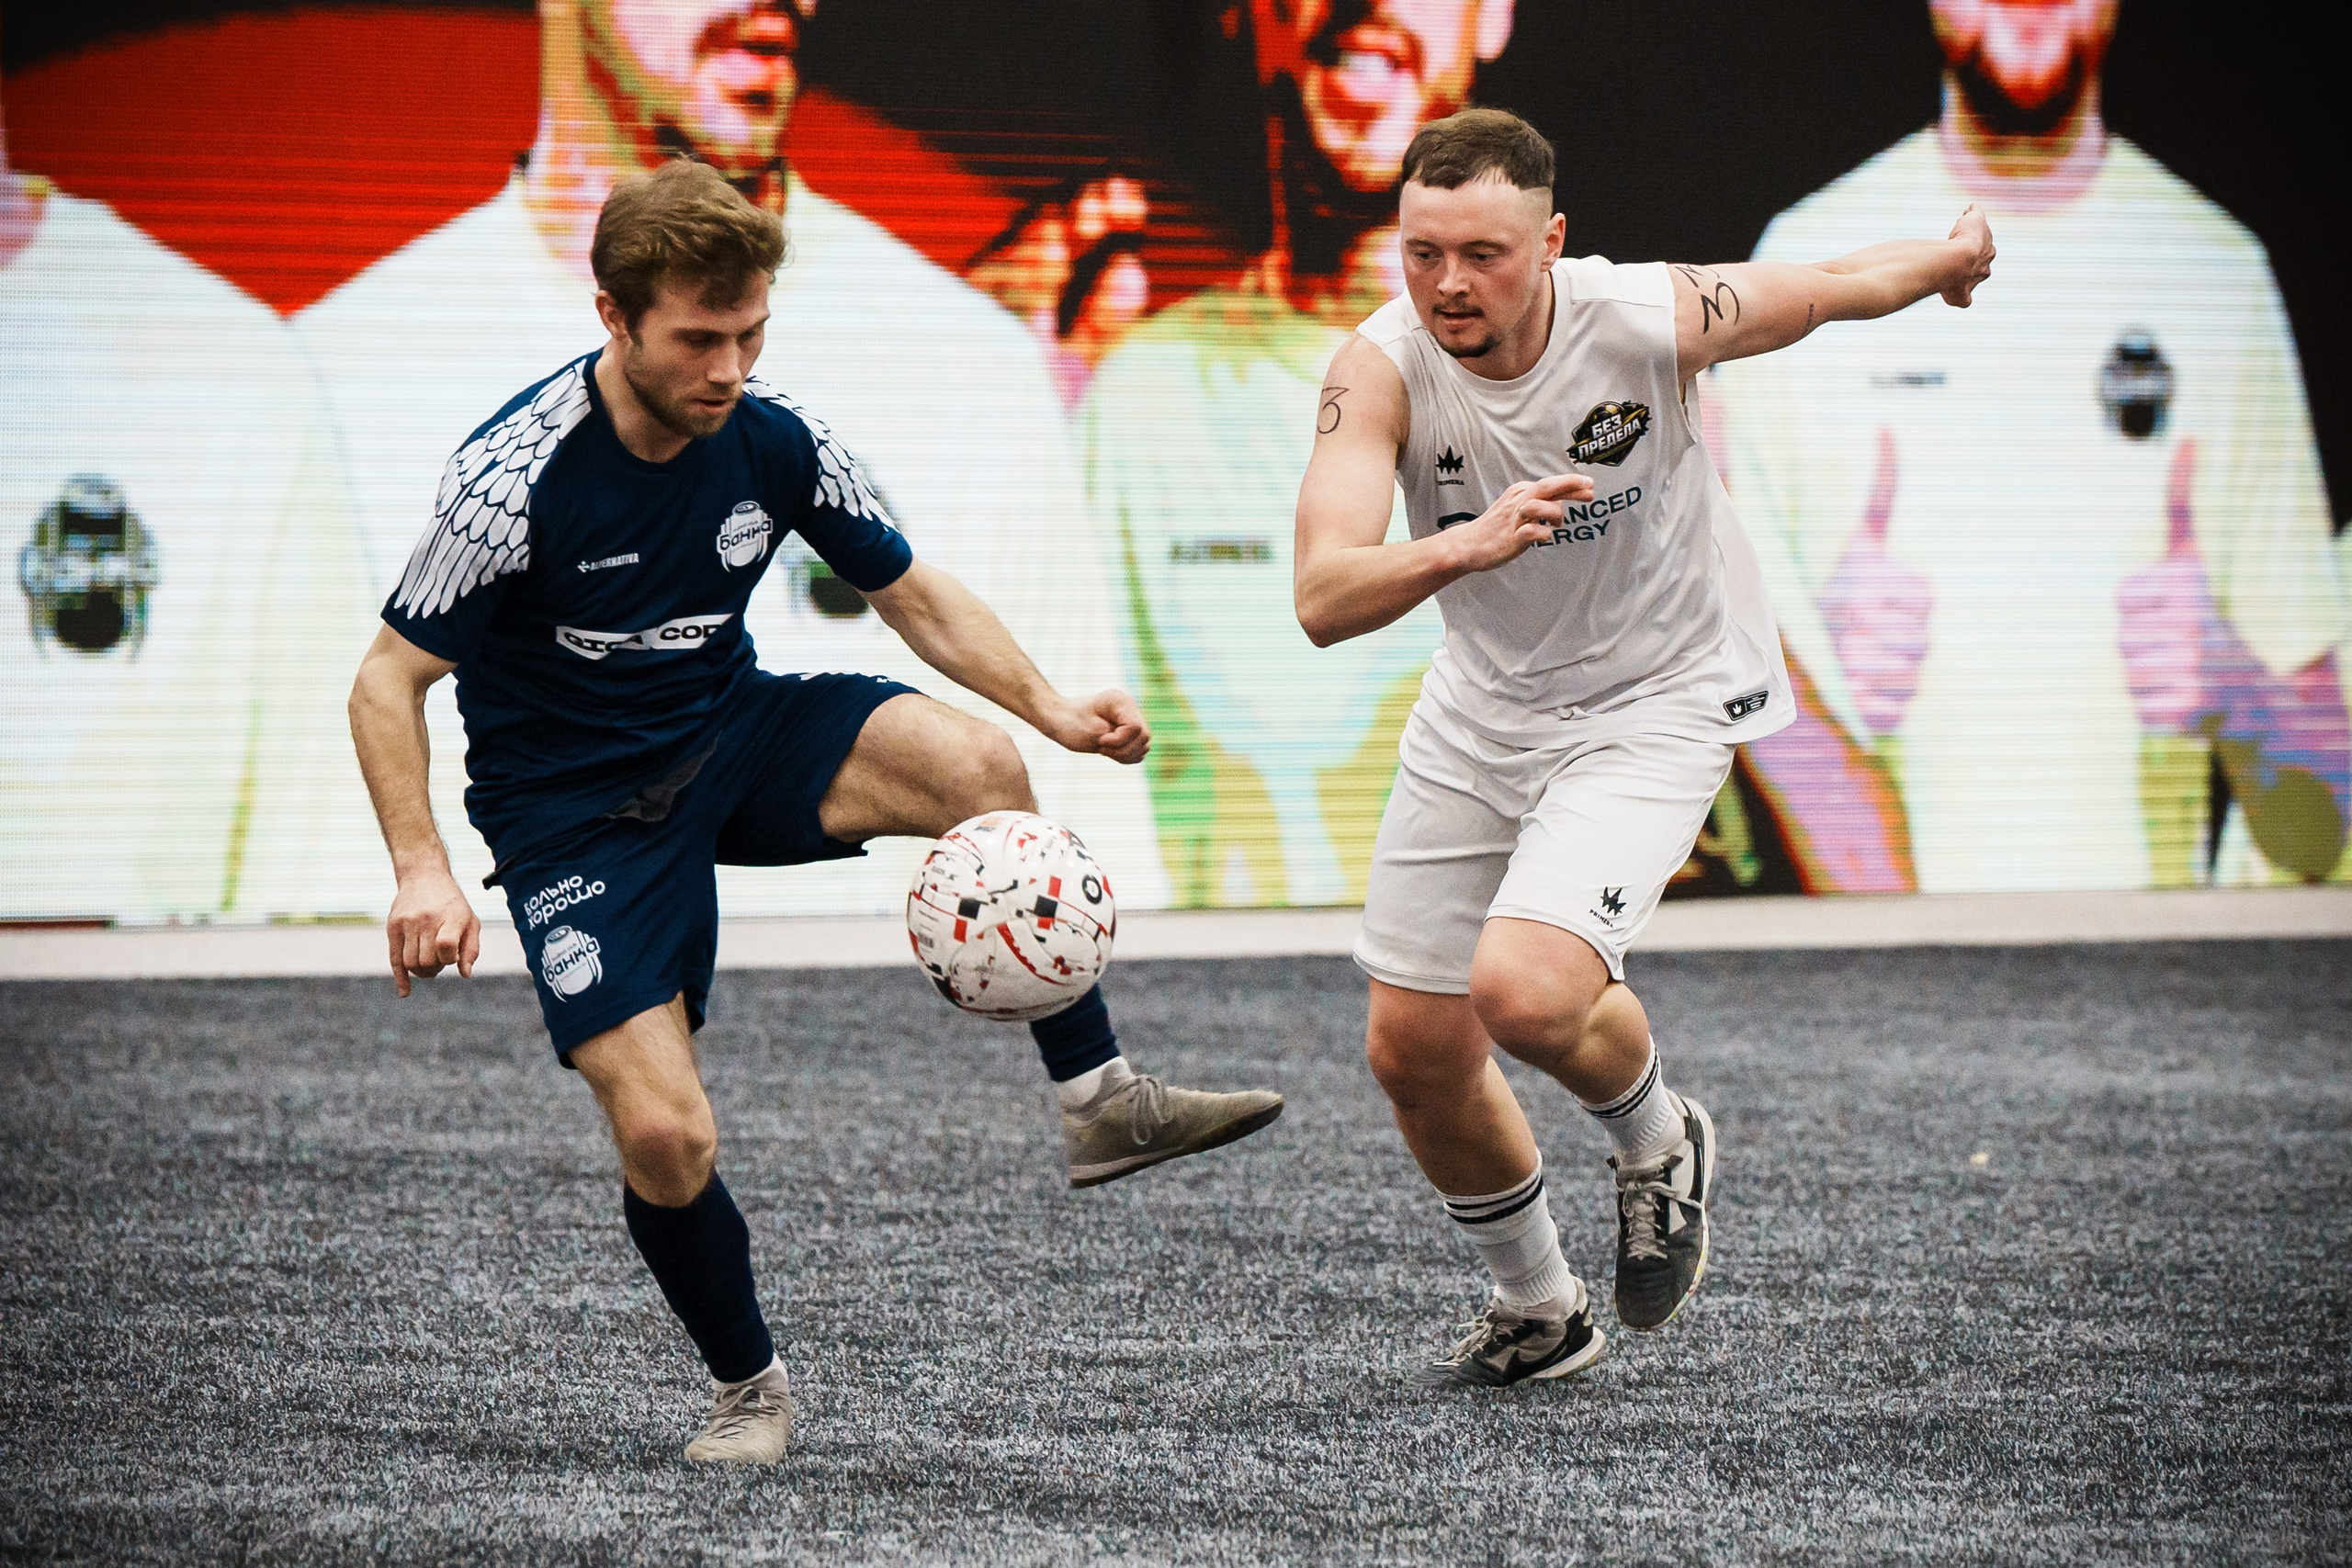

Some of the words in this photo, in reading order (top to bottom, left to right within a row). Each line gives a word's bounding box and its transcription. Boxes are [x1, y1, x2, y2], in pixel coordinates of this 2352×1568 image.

[1317, 387, 1350, 434] 3
[1591, 414, 1623, 439] БЕЗ
[1578, 418, 1642, 459] ПРЕДЕЛА
[1532, 519, 1611, 548] RGY
